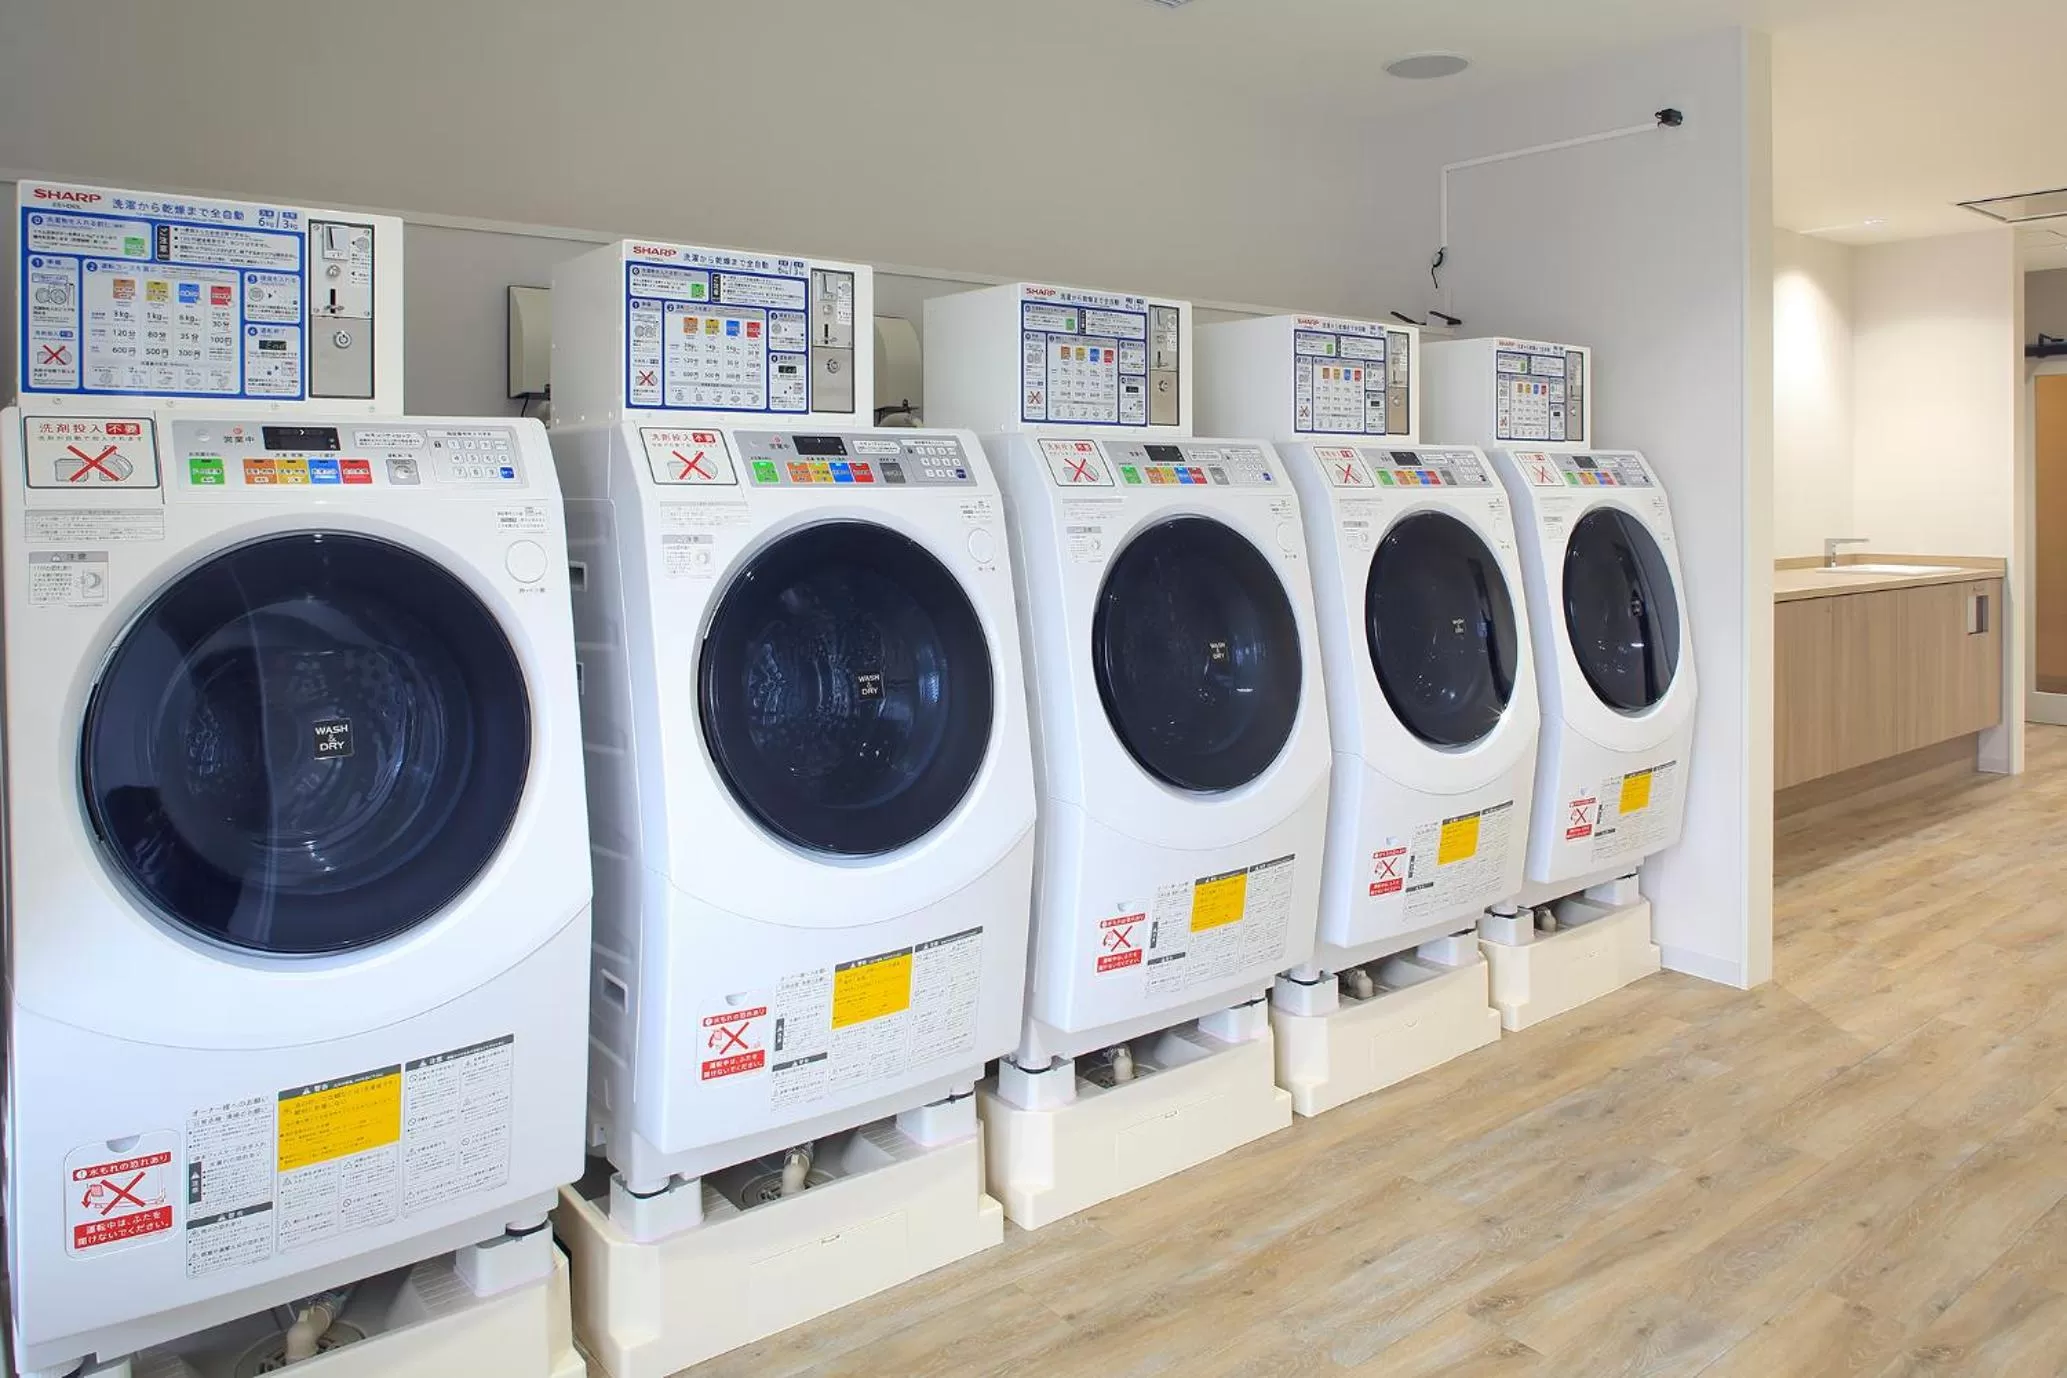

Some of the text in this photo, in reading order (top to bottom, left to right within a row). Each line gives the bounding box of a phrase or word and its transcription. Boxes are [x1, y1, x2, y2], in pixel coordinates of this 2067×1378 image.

[33, 188, 102, 203] SHARP
[112, 198, 245, 222] 洗濯から乾燥まで全自動
[632, 246, 677, 256] SHARP
[1026, 288, 1056, 297] SHARP
[40, 424, 139, 434] 洗剤投入不要
[858, 674, 880, 682] WASH
[862, 687, 878, 695] DRY
[315, 724, 348, 735] WASH
[320, 742, 344, 751] DRY
